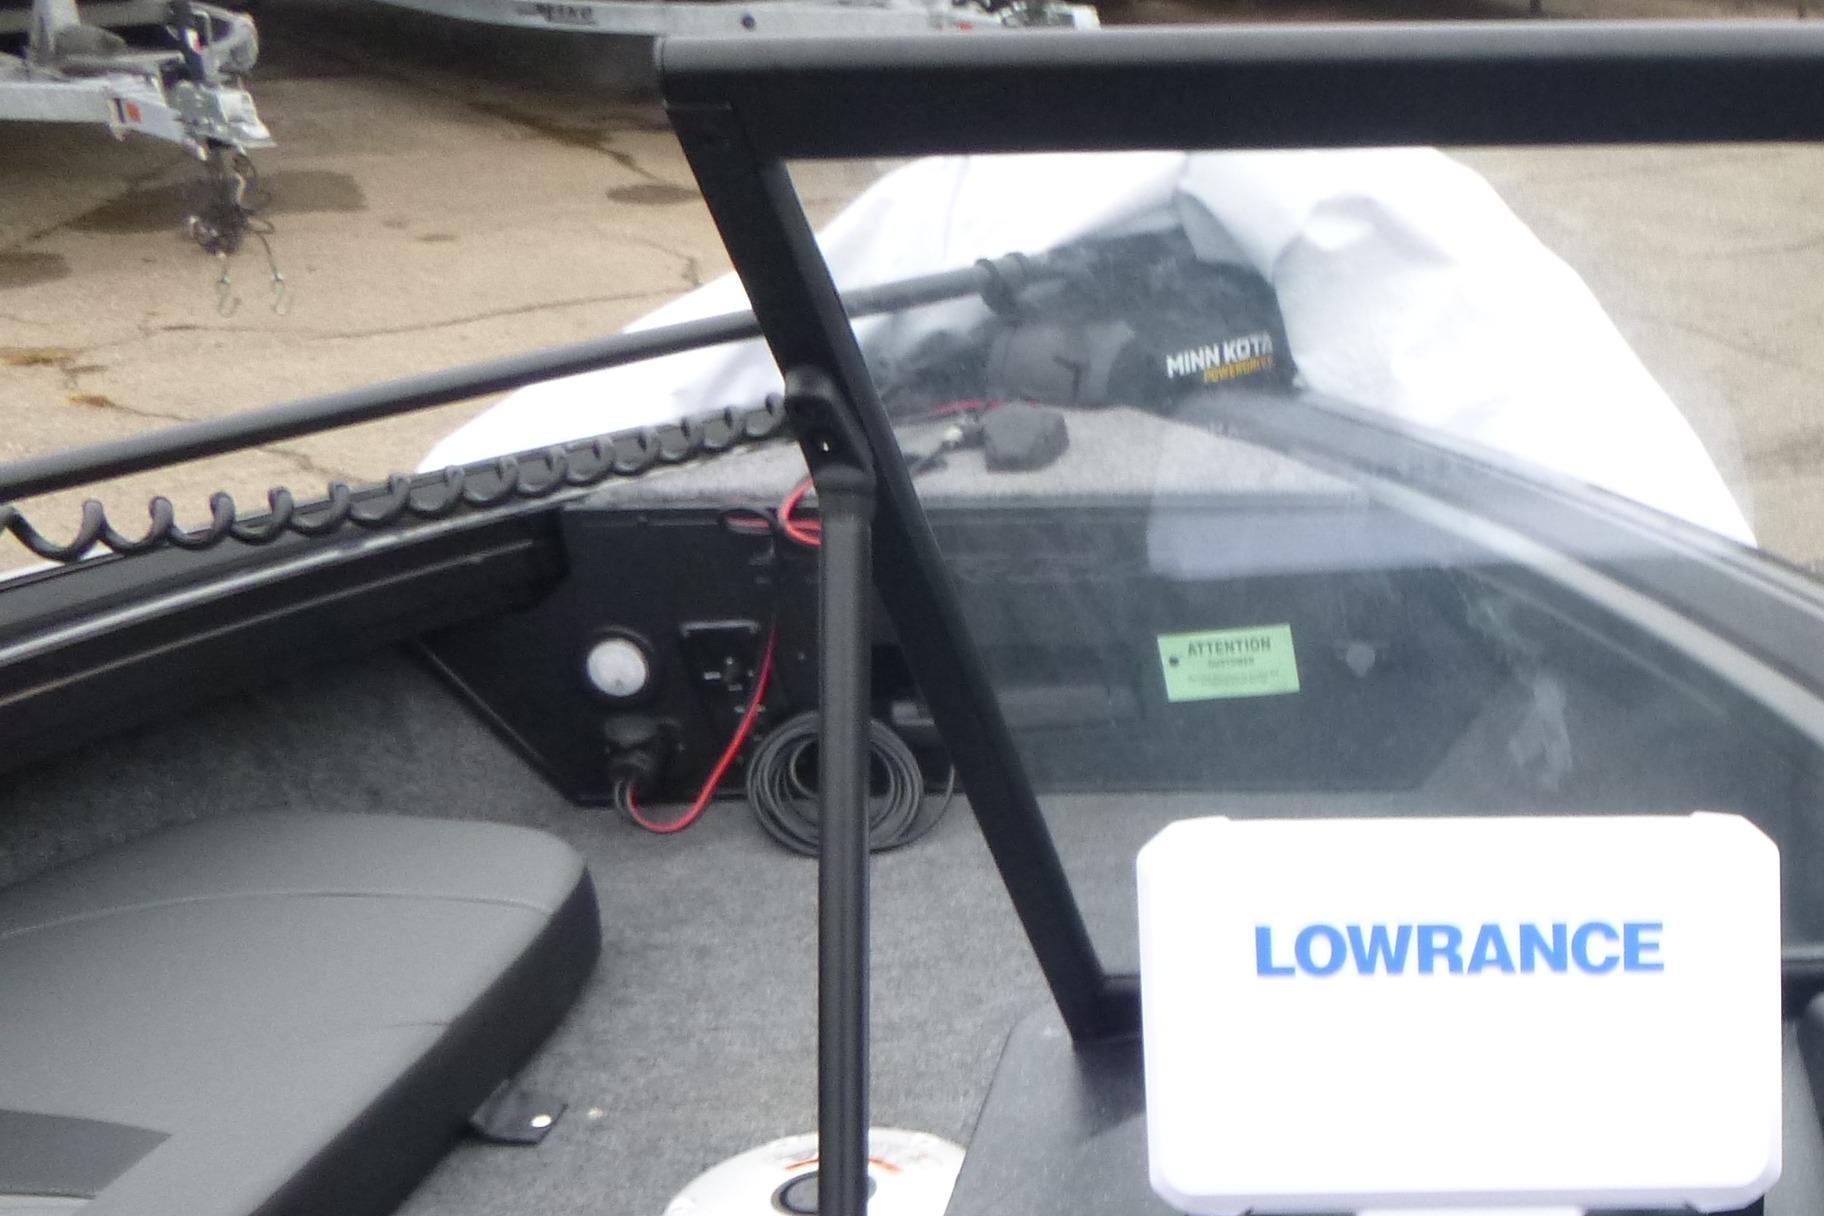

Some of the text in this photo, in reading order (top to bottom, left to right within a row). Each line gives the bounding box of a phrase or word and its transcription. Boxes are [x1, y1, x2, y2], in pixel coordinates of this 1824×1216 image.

[1166, 331, 1273, 379] MINN KOTA
[1187, 636, 1271, 656] ATTENTION
[1254, 921, 1664, 977] LOWRANCE
